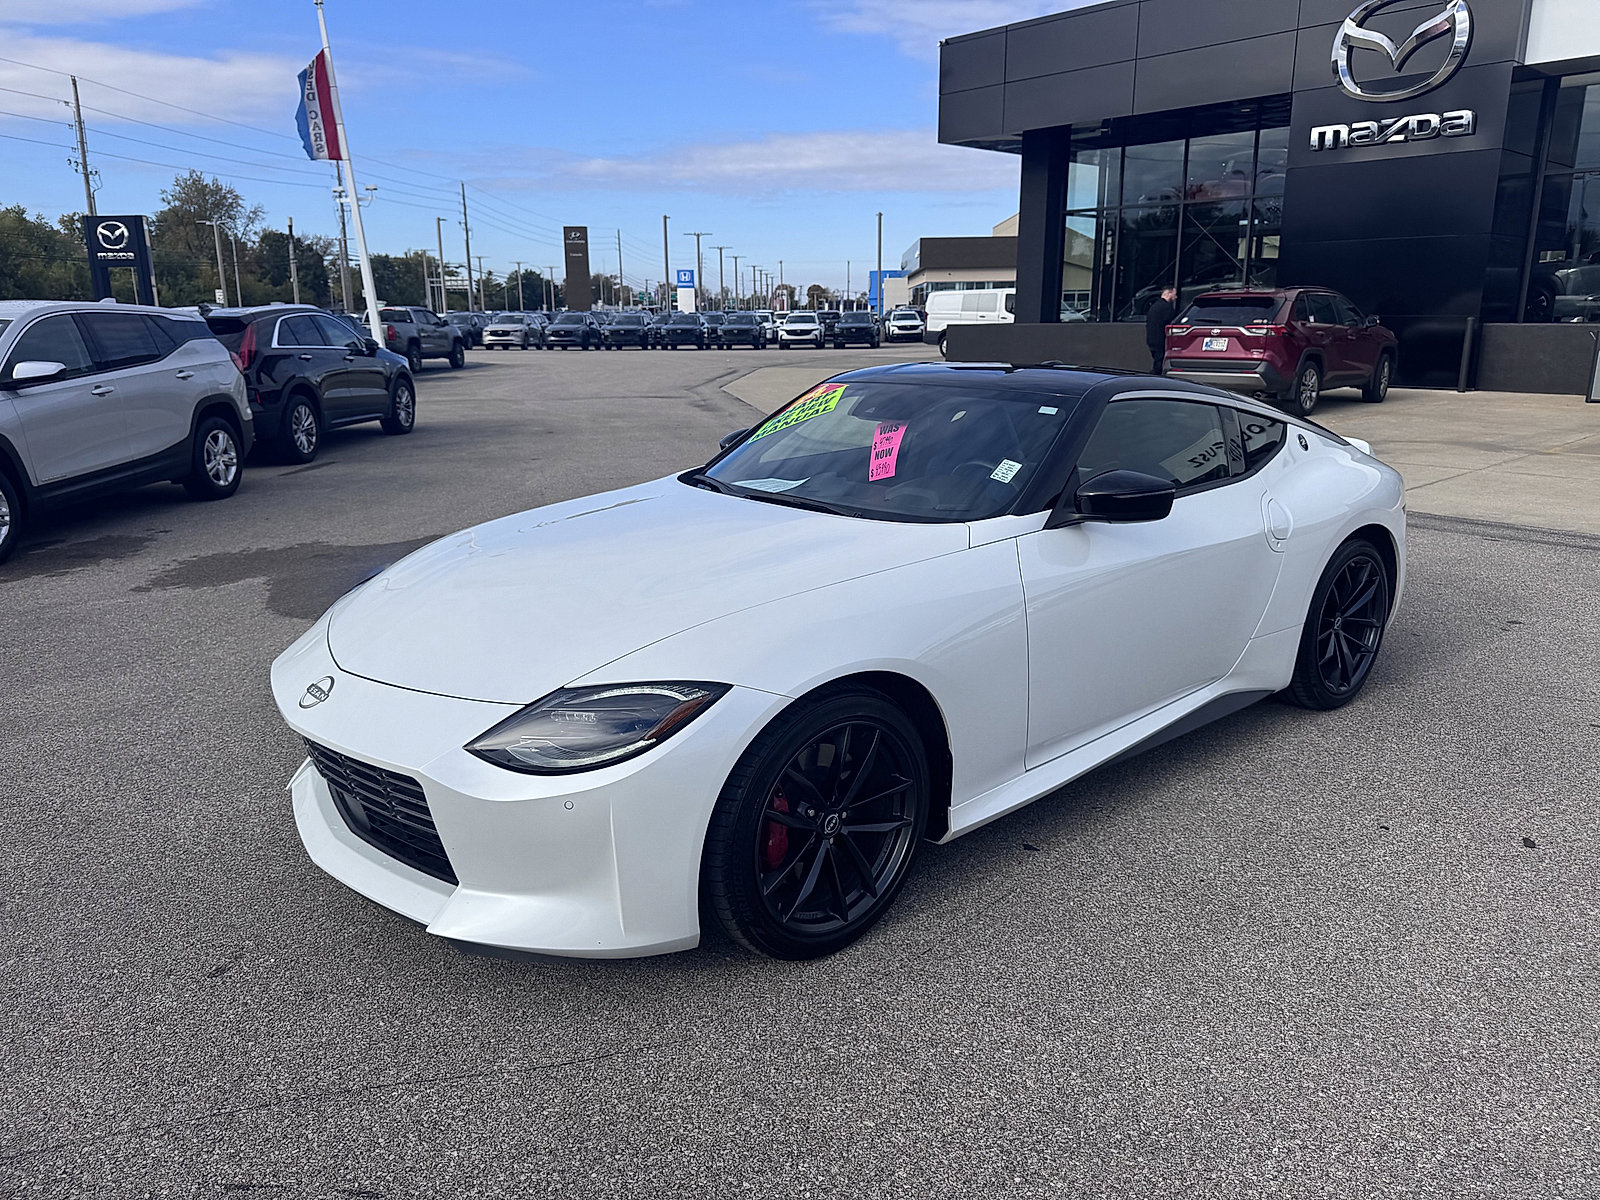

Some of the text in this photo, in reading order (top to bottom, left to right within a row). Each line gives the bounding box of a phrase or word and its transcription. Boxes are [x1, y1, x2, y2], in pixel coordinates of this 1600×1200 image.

[1310, 109, 1477, 151] mazda
[879, 423, 900, 436] WAS
[874, 446, 895, 461] NOW
[308, 685, 327, 701] SSAN
